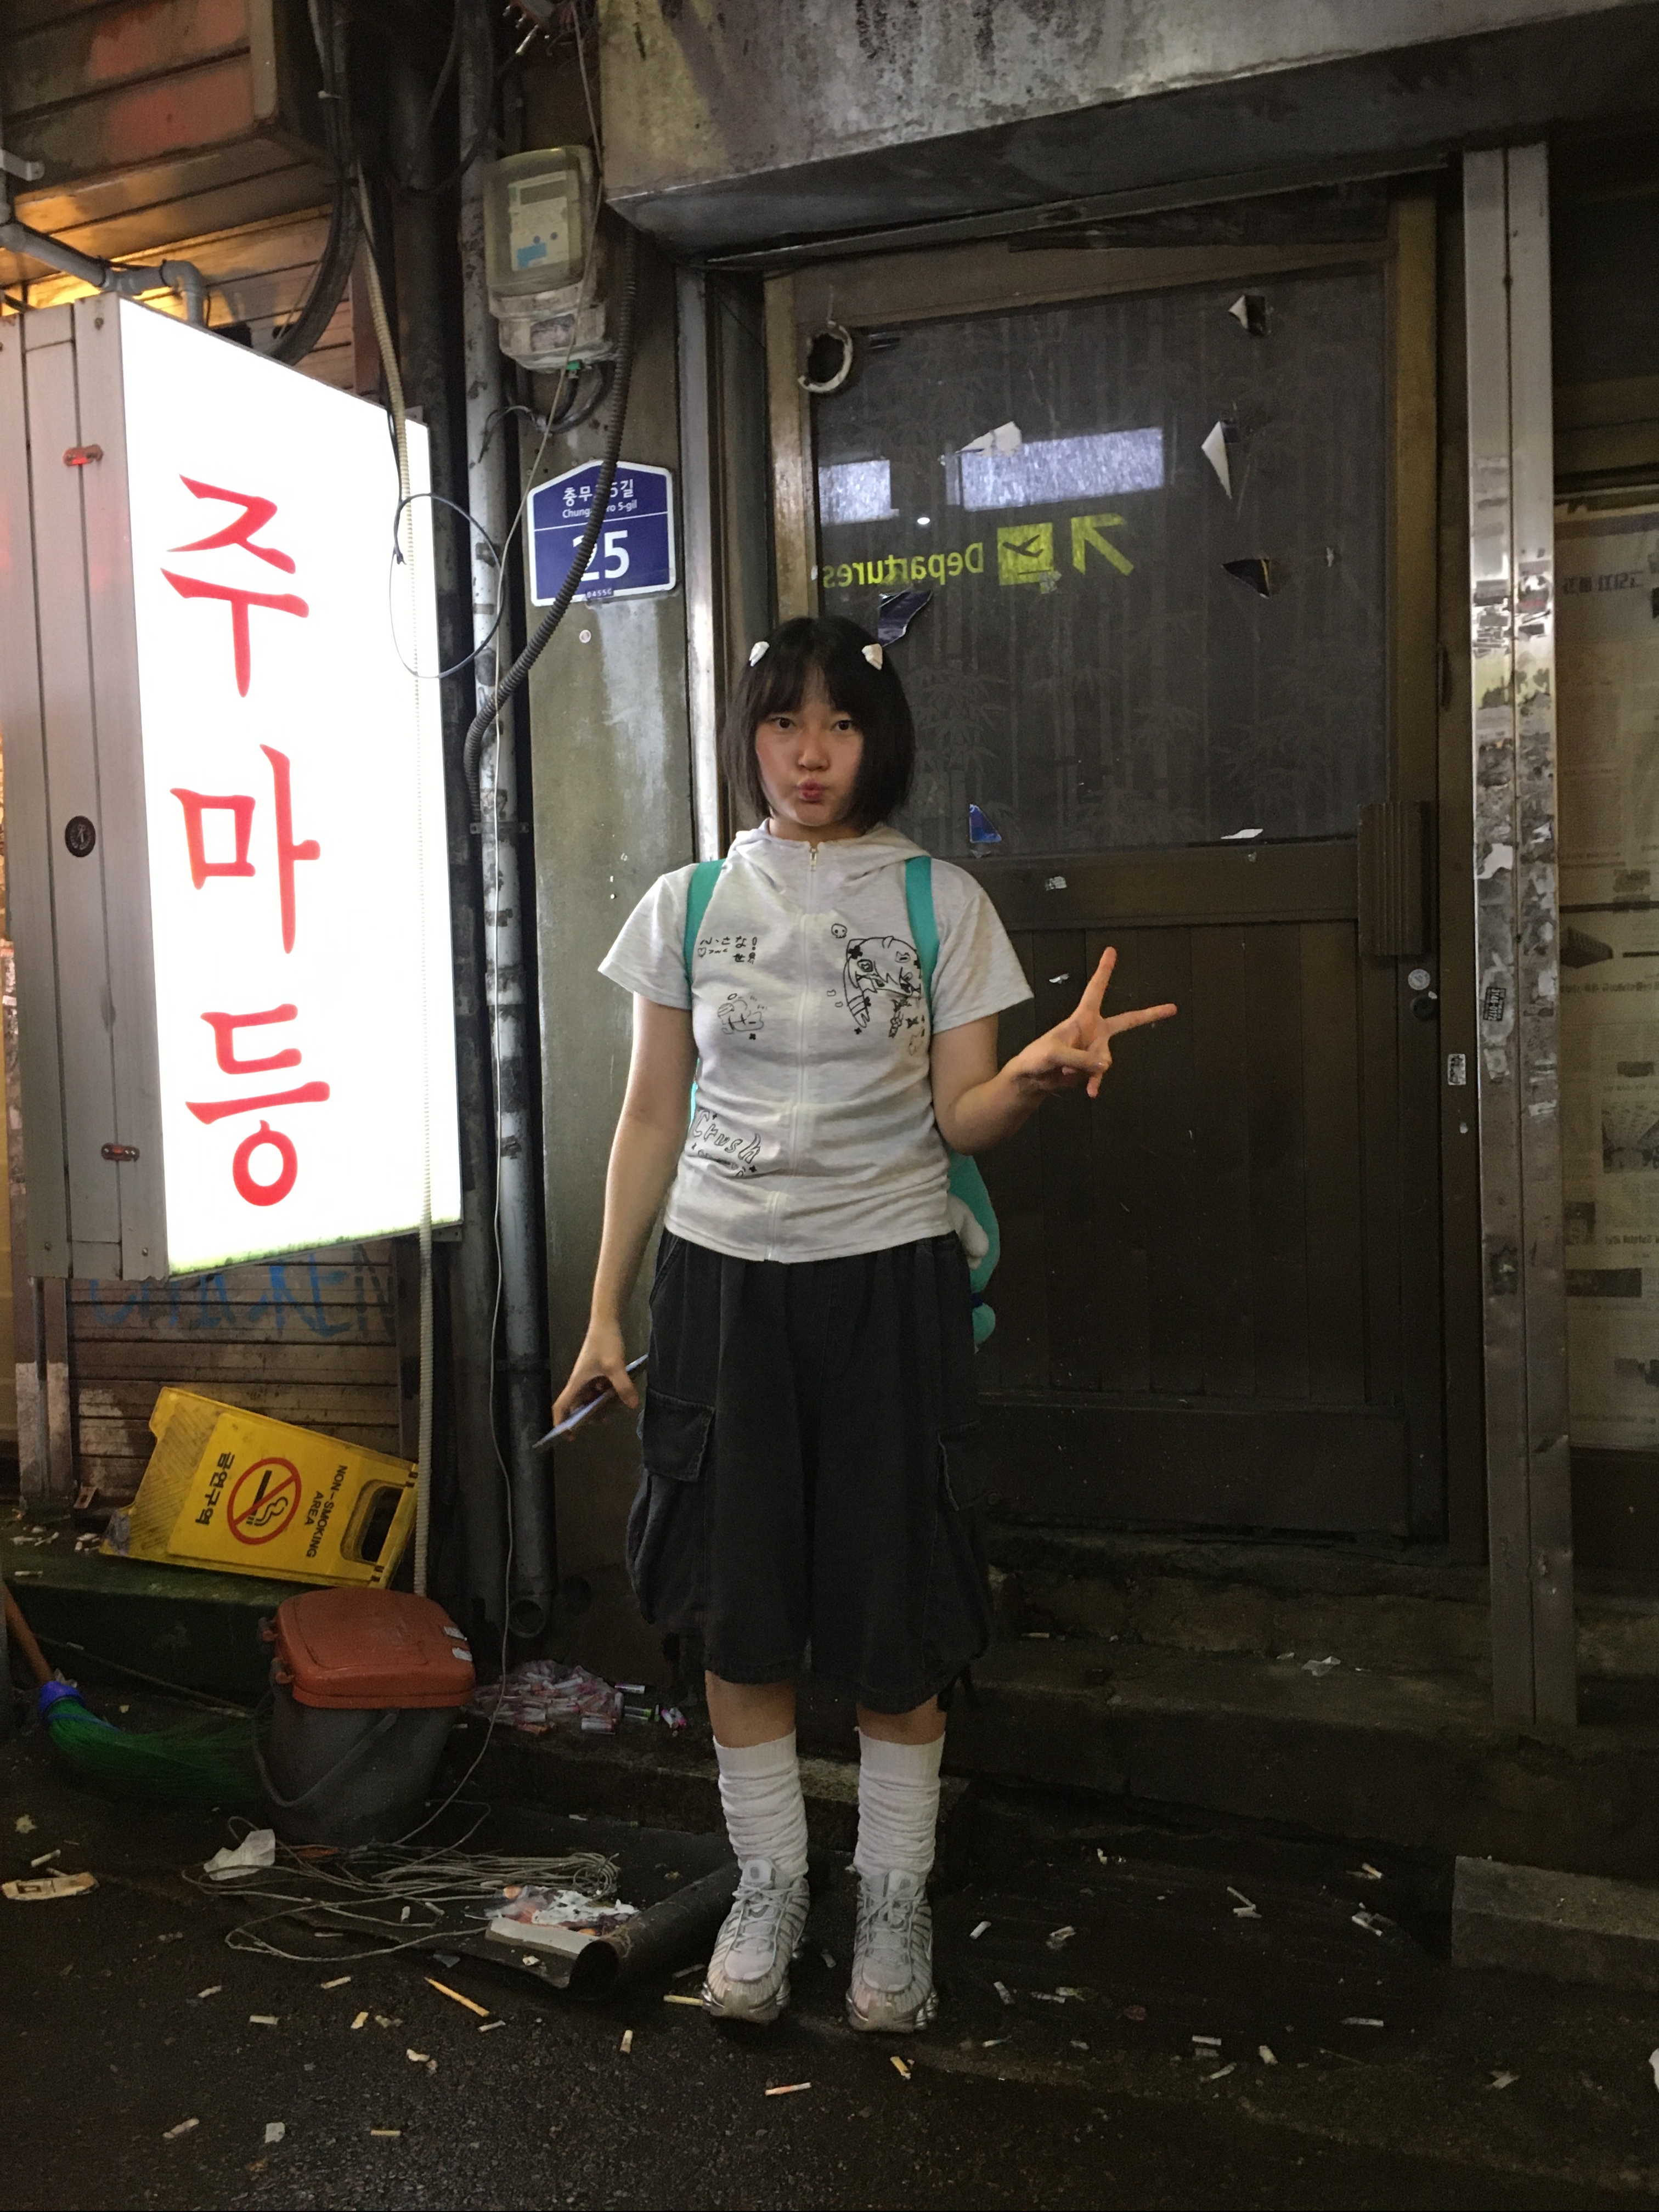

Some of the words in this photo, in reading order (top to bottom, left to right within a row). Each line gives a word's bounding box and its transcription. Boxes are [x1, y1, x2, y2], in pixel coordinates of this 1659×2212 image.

[562, 479, 634, 507] 충무5길
[618, 499, 637, 512] 5-gil
[160, 473, 330, 1206] 주마등
[195, 1451, 235, 1526] 금연구역
[304, 1491, 324, 1525] AREA
[306, 1465, 348, 1558] NON-SMOKING
